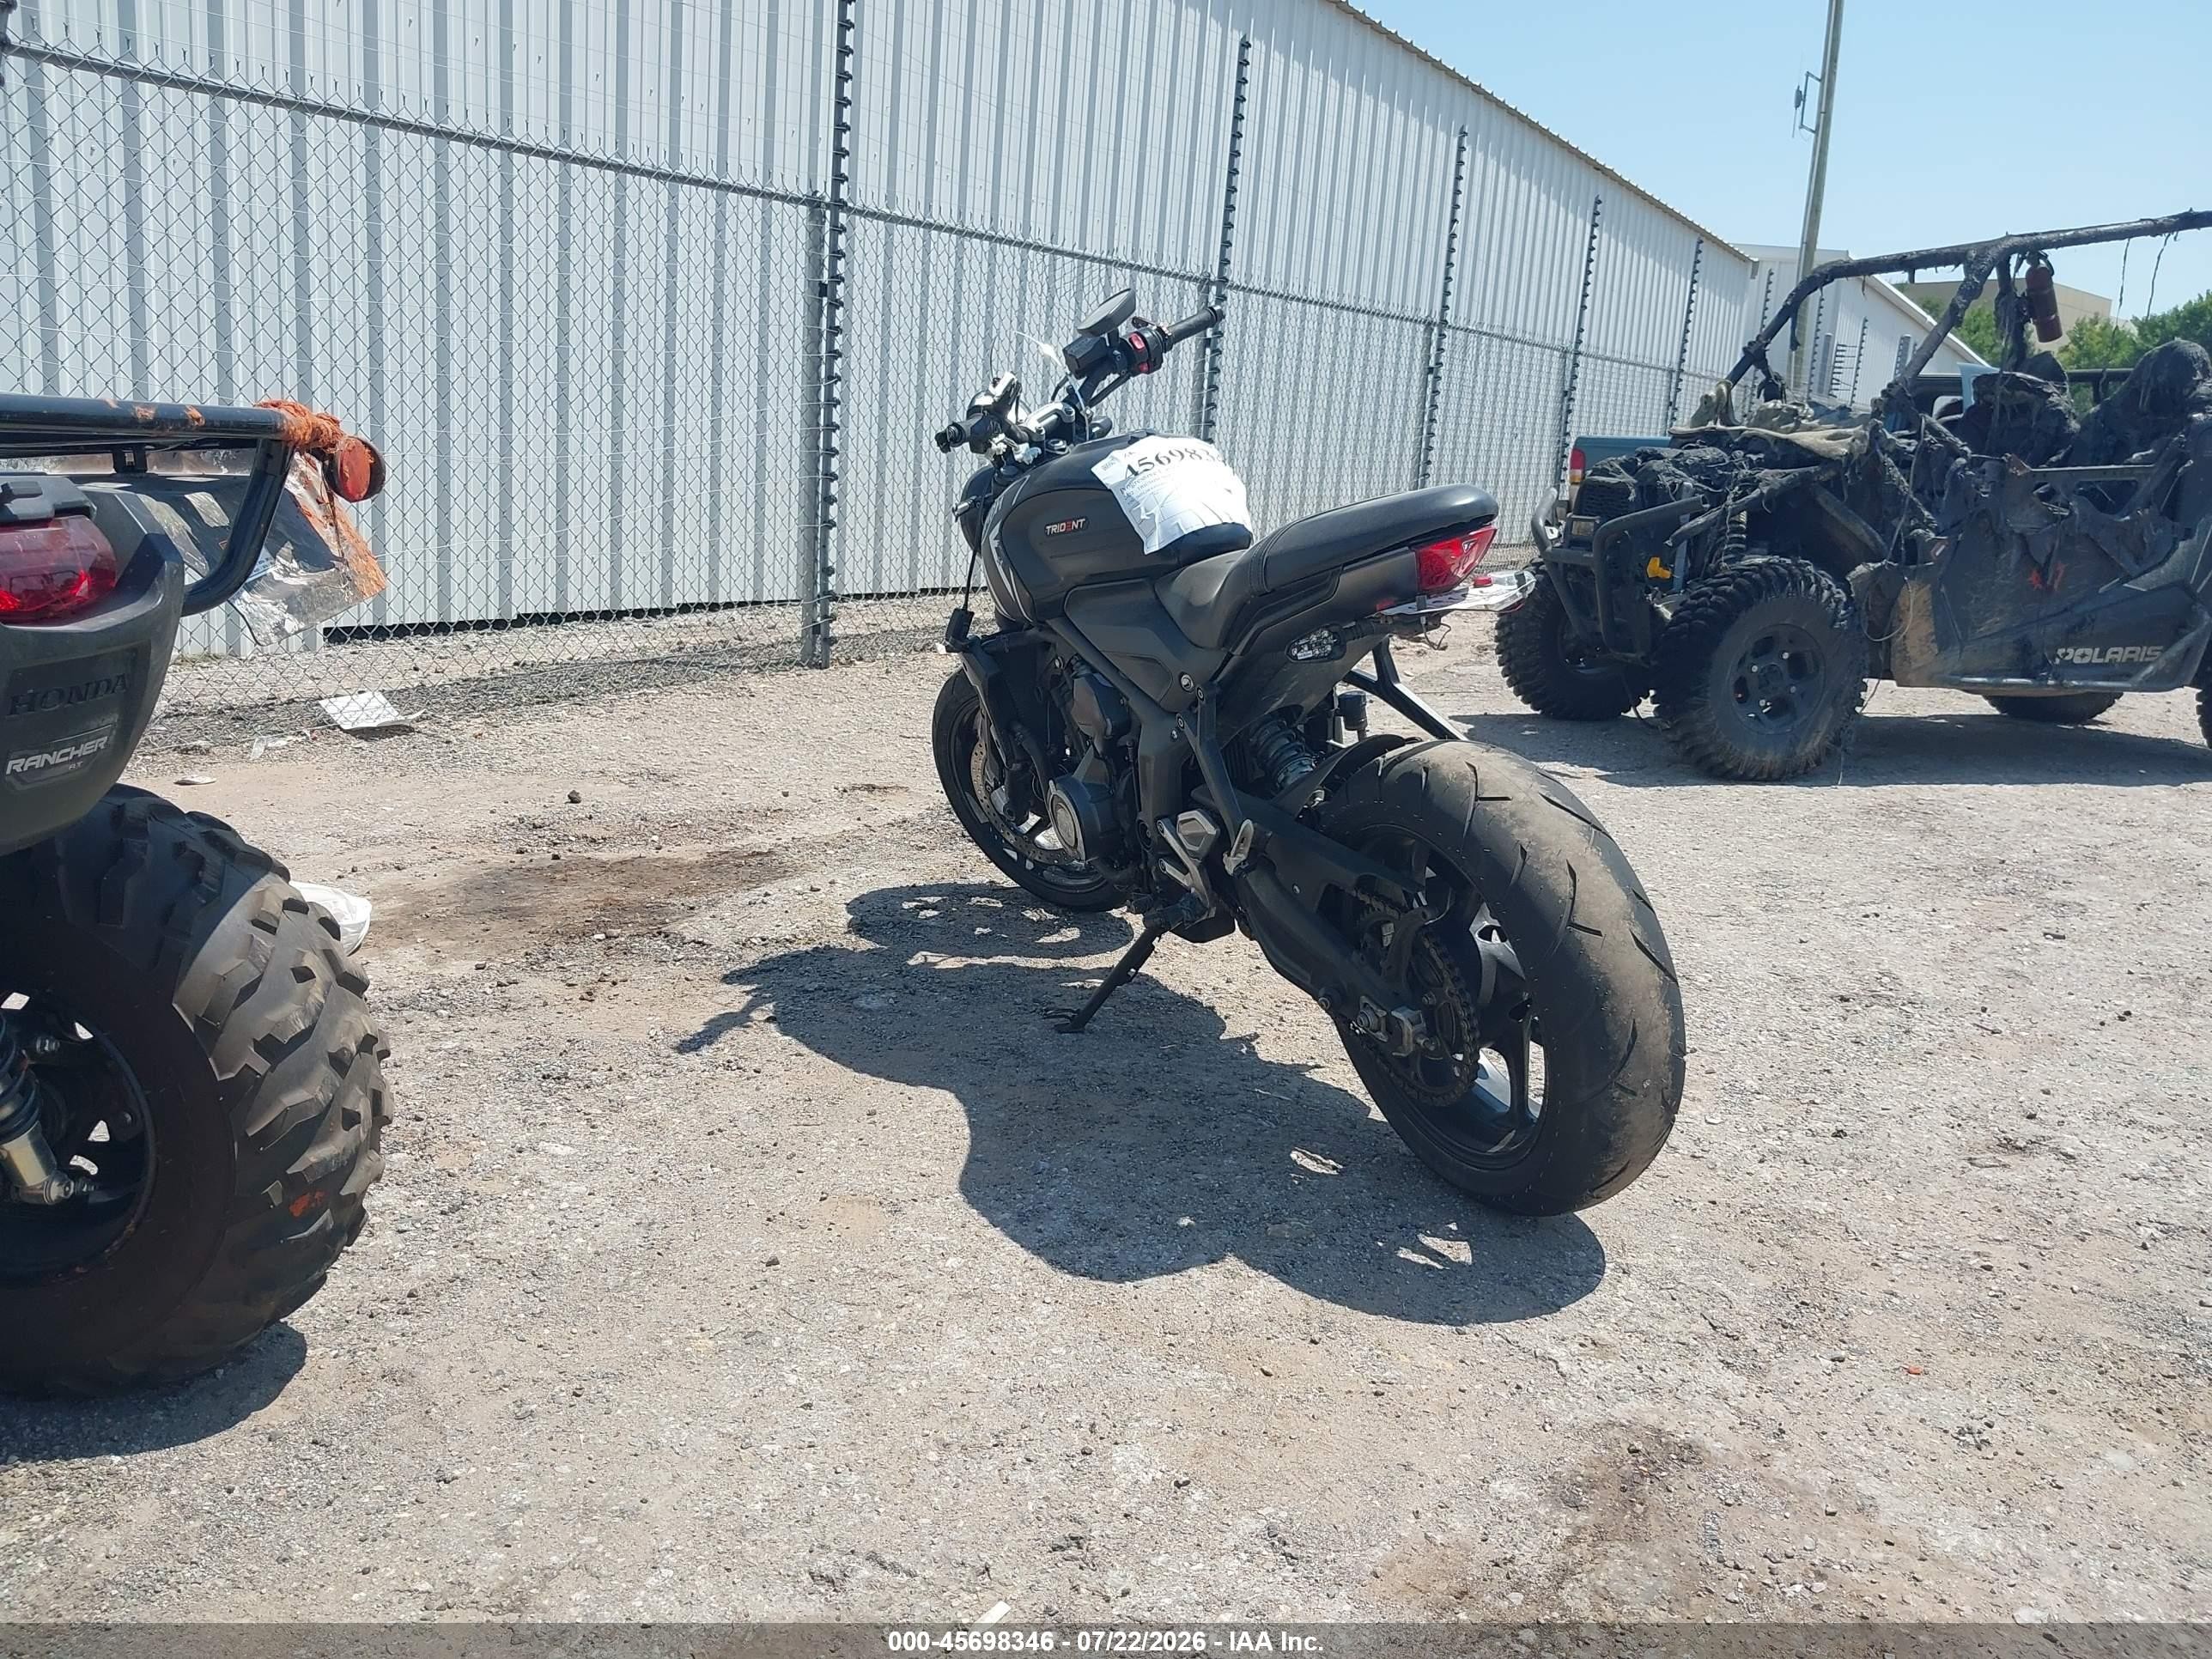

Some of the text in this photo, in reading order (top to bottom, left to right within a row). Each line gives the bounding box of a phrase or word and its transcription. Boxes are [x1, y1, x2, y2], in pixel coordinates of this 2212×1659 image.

[1045, 518, 1086, 536] TRIDENT
[2055, 645, 2164, 665] POLARIS
[6, 672, 129, 718] HONDA
[5, 736, 109, 775] RANCHER
